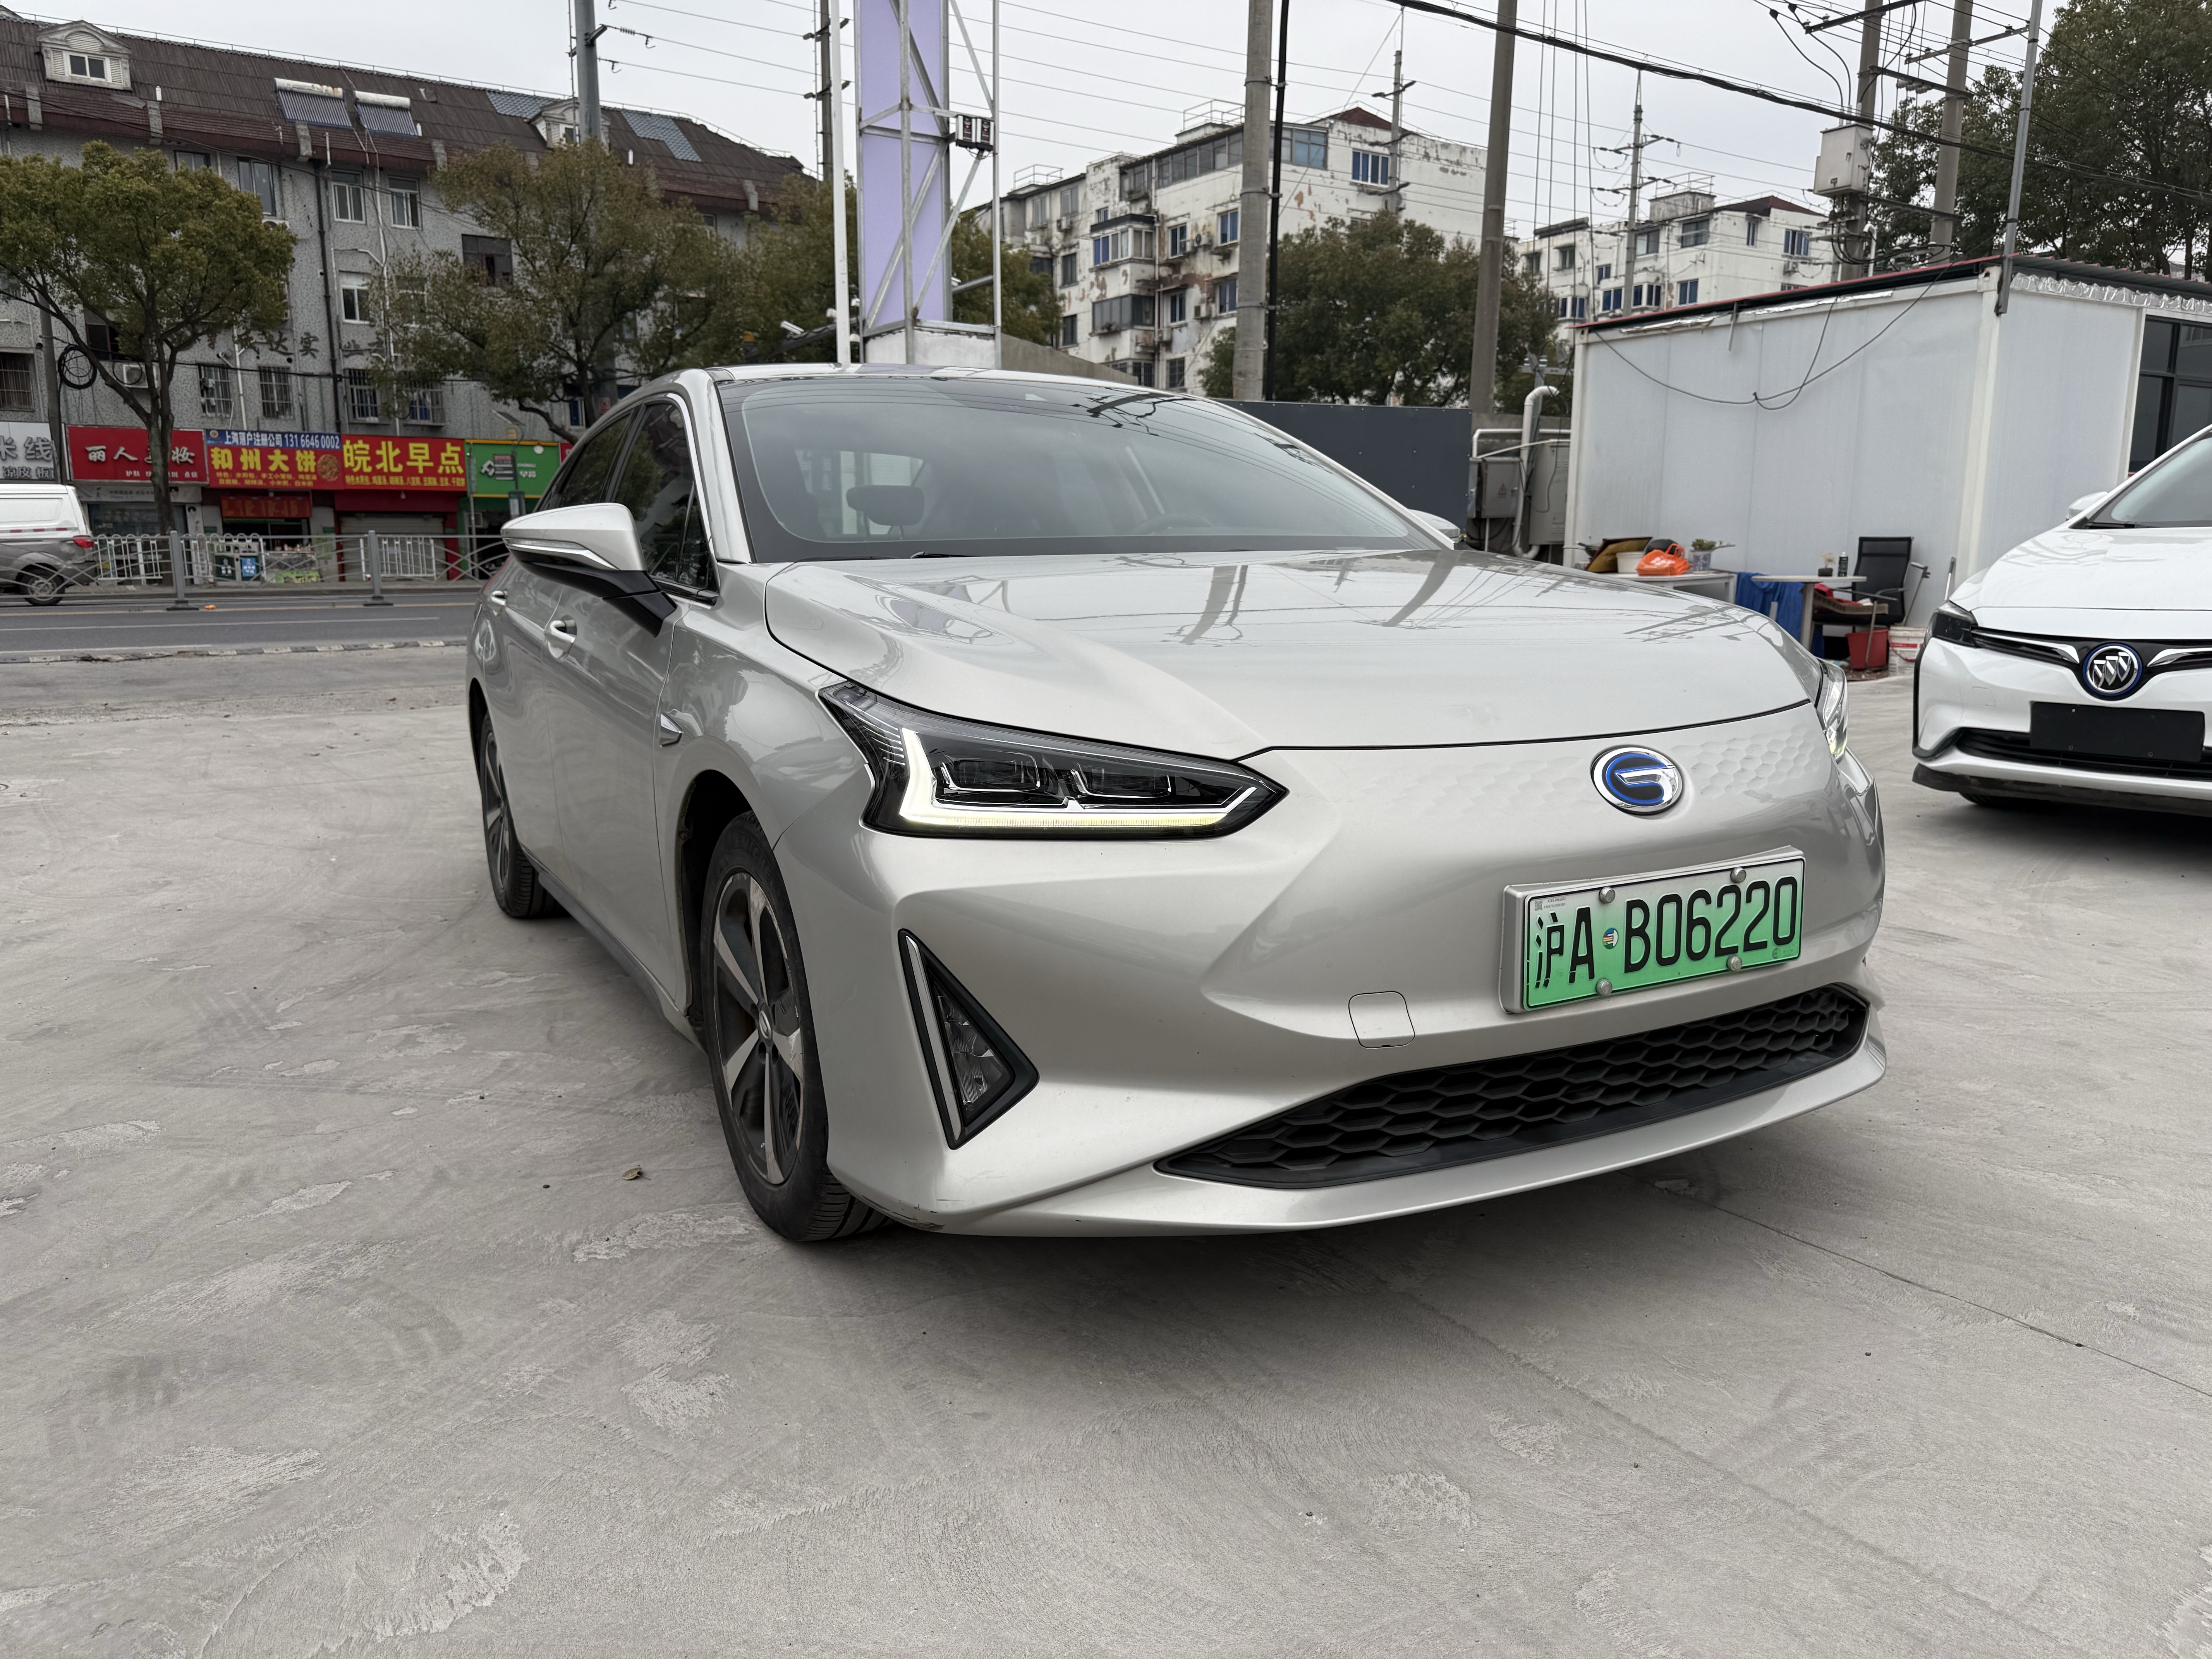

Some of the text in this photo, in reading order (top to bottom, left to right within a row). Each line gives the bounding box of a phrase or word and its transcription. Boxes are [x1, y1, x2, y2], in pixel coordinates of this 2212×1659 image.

[225, 431, 340, 449] 上海落户注册公司 131 6646 0002
[210, 447, 316, 473] 和州大饼
[343, 440, 464, 474] 皖北早点
[1624, 876, 1798, 974] B06220
